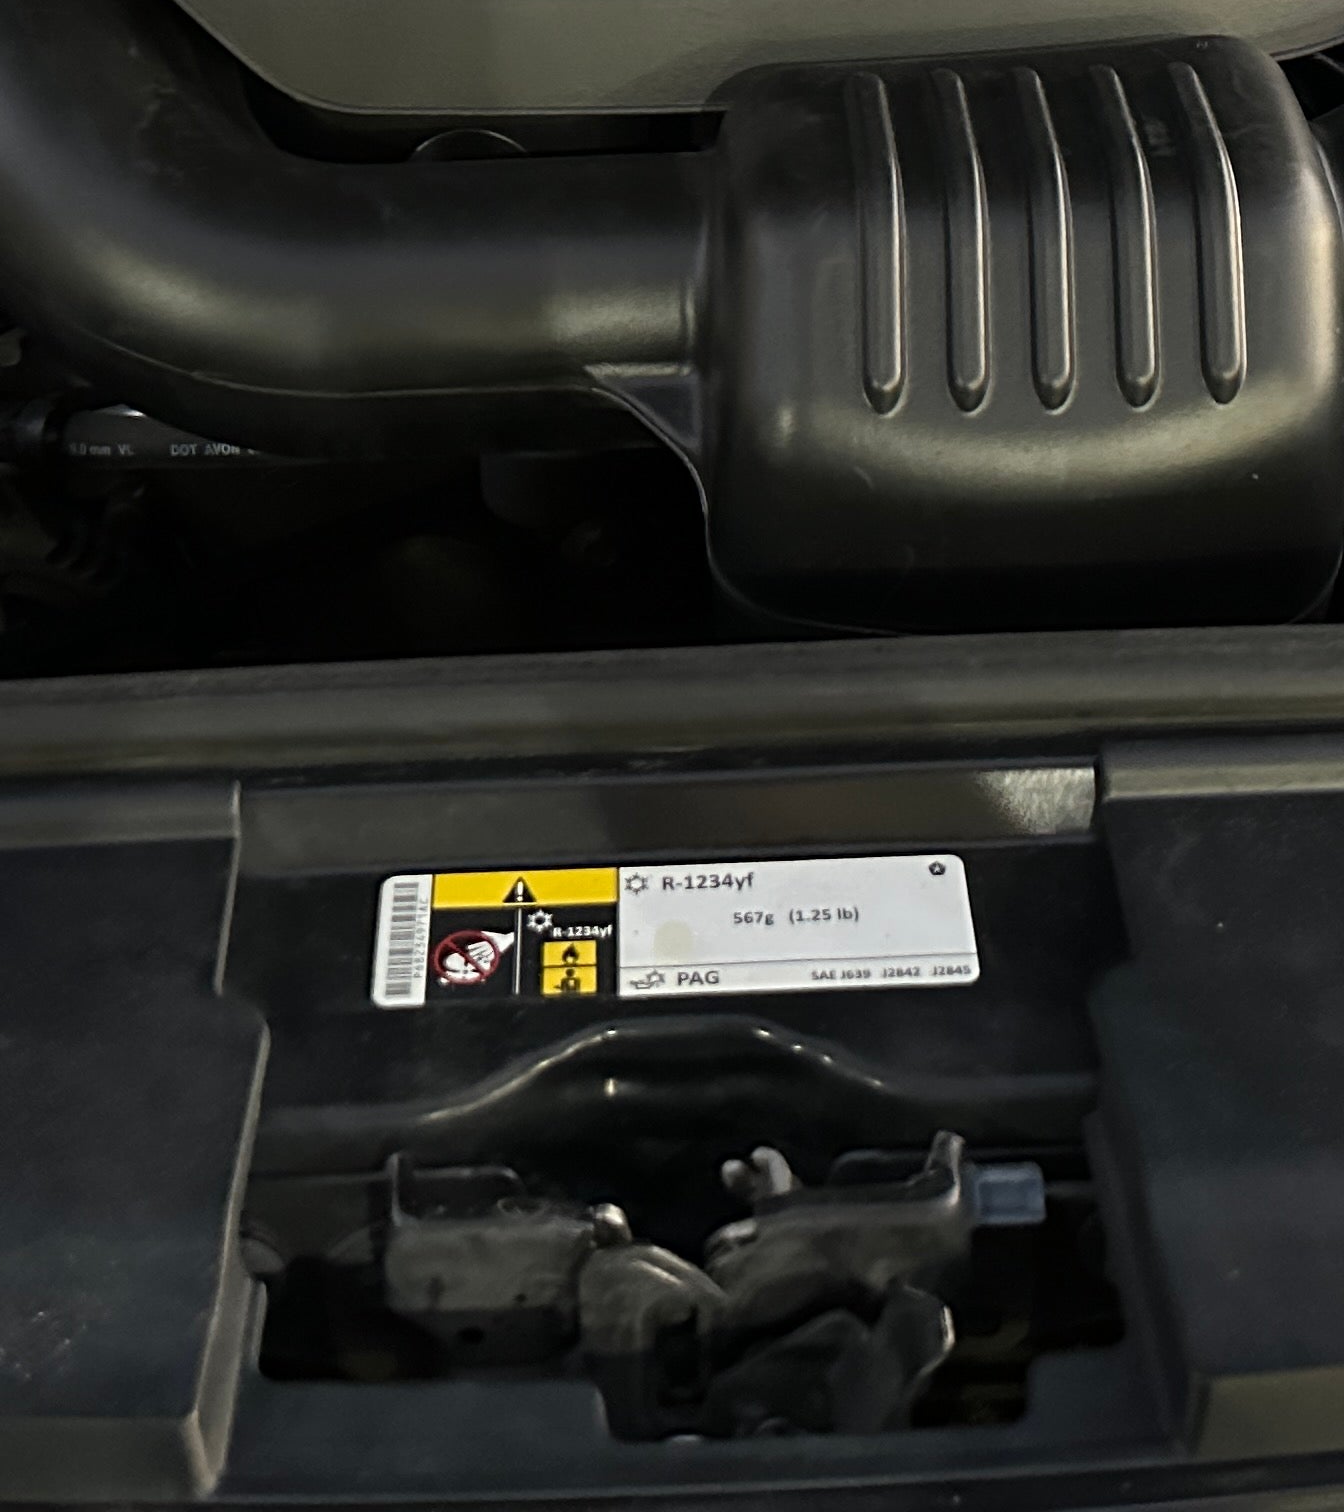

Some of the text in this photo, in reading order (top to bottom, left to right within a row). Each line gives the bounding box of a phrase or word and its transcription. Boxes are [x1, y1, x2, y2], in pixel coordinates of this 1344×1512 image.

[170, 443, 197, 456] DOT
[662, 872, 754, 891] R-1234yf
[733, 907, 859, 925] 567g (1.25 lb)
[552, 924, 613, 938] R-1234yf
[677, 970, 720, 985] PAG
[811, 970, 836, 980] SAE
